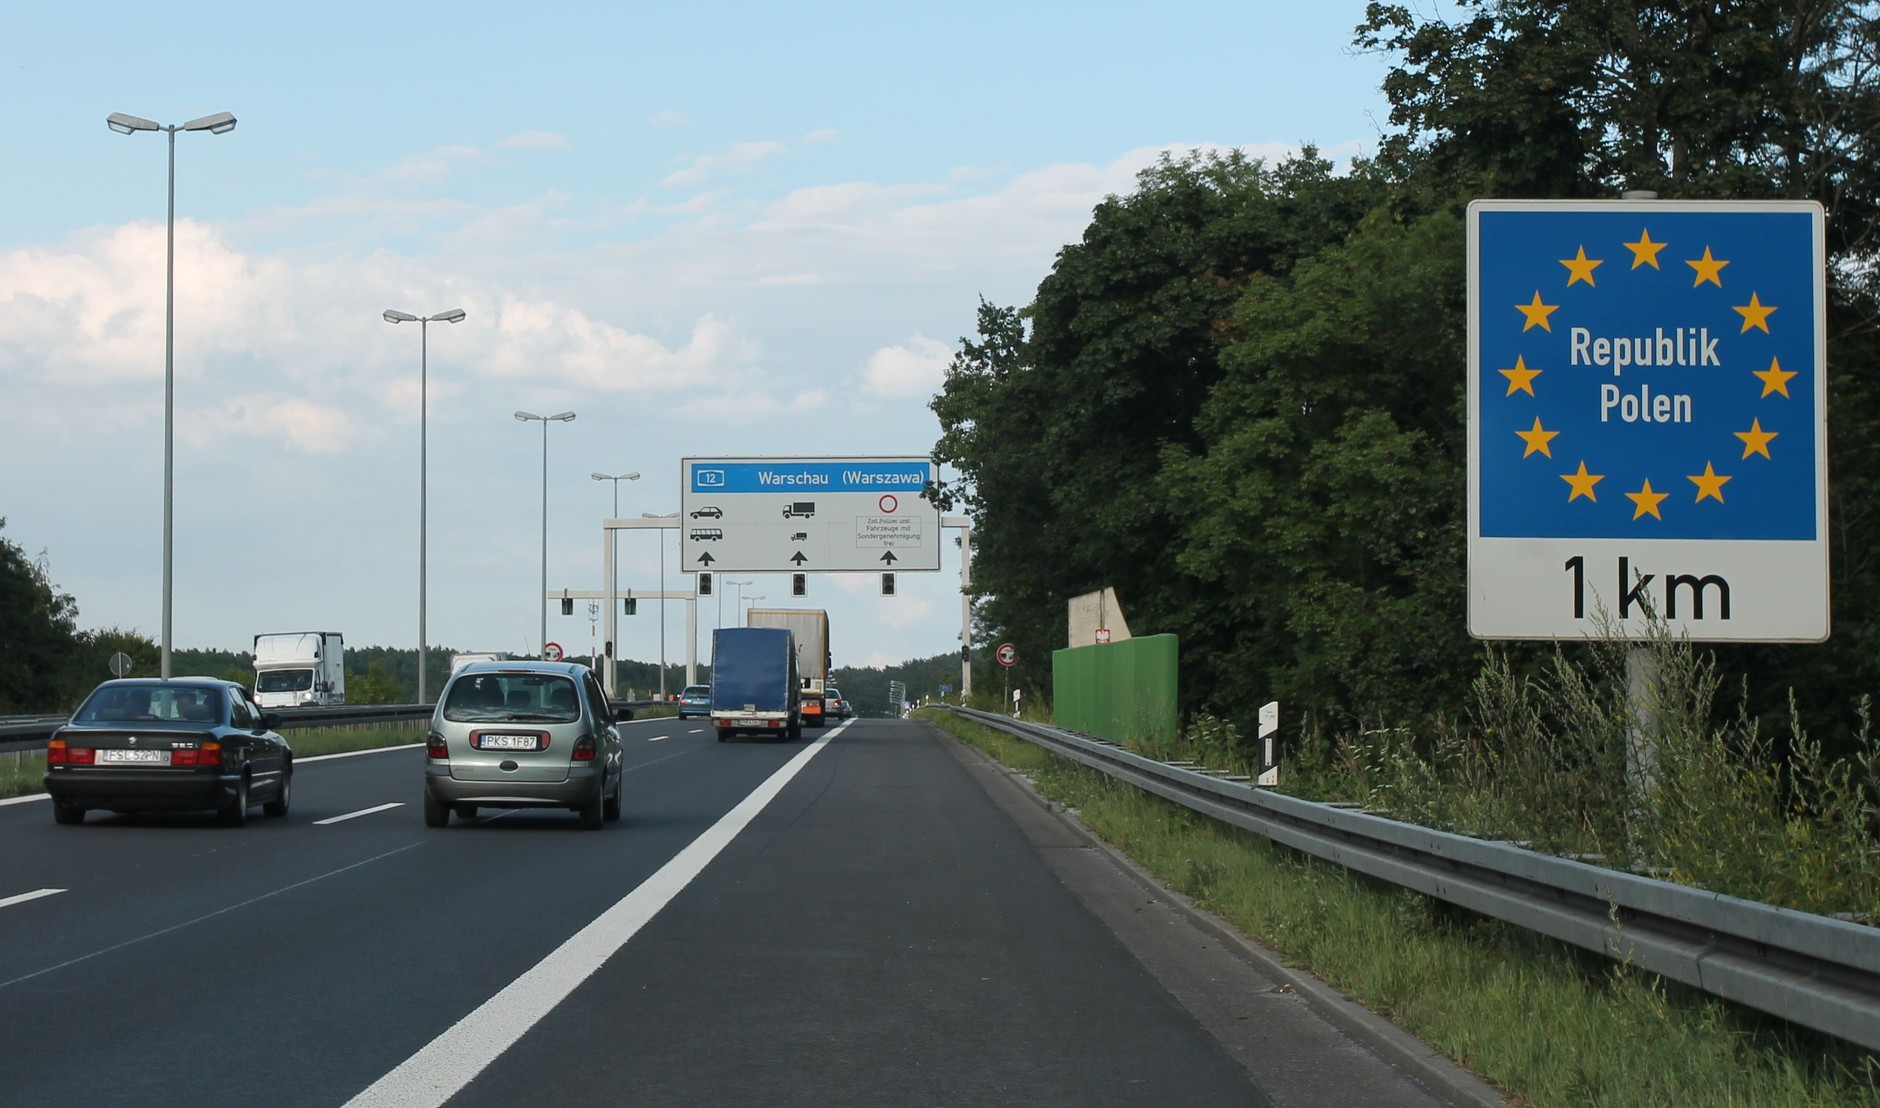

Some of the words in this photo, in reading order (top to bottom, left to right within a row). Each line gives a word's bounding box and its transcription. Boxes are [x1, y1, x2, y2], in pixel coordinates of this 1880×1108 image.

[1569, 327, 1721, 376] Republik
[1600, 383, 1692, 423] Polen
[706, 473, 716, 484] 12
[758, 471, 829, 485] Warschau
[842, 470, 924, 485] (Warszawa)
[866, 525, 899, 533] Fahrzeuge
[857, 532, 921, 541] Sondergenehmigung
[1564, 555, 1584, 619] 1
[1618, 556, 1731, 620] km
[487, 736, 509, 747] PKS
[512, 736, 536, 747] 1F87
